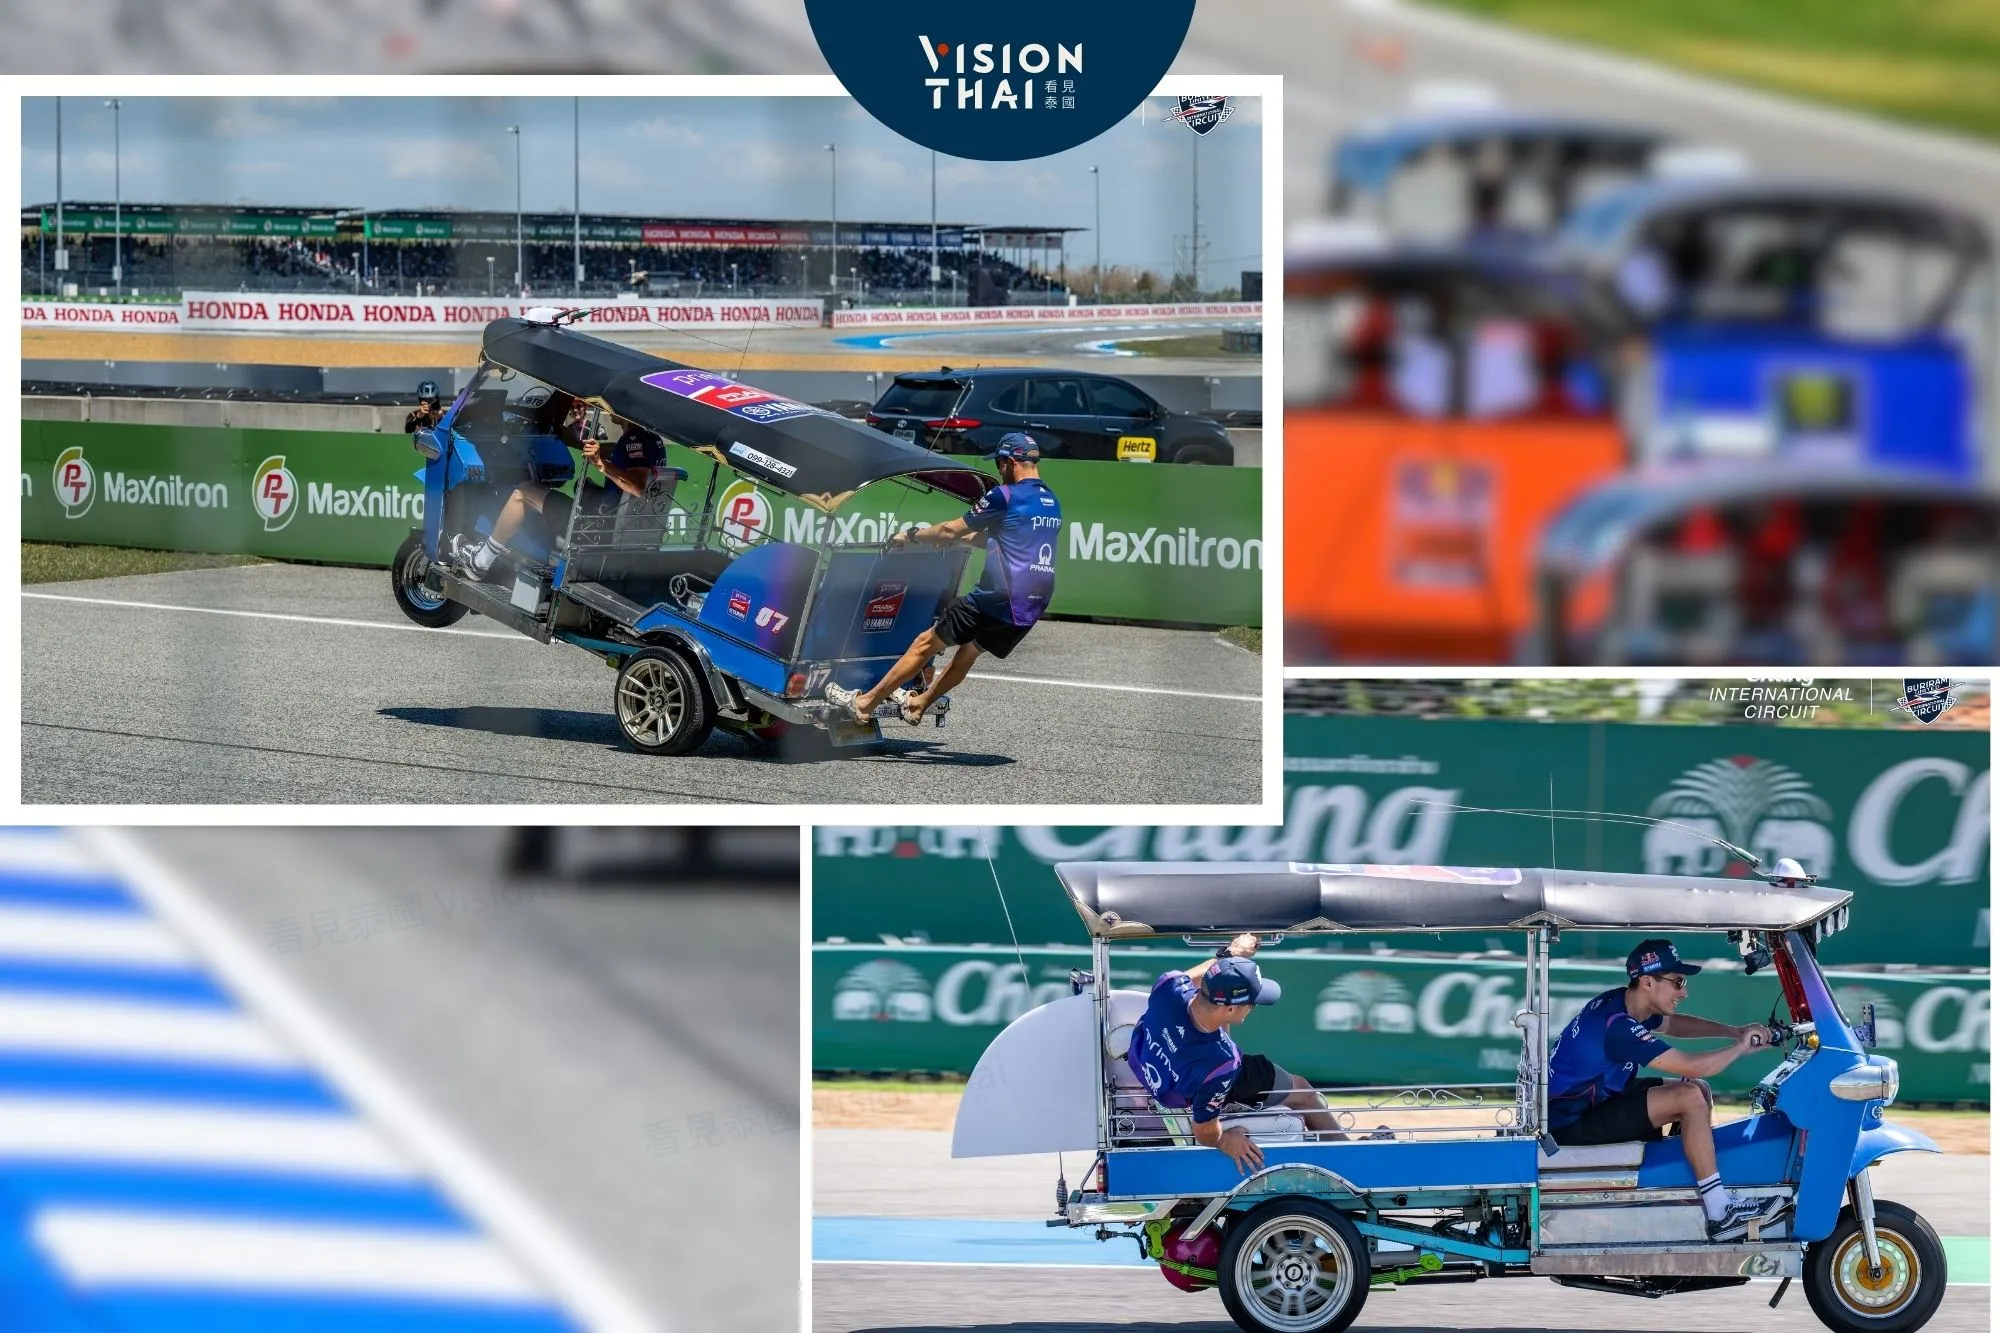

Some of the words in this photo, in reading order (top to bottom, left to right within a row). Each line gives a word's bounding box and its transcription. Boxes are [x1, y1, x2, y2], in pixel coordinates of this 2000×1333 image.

[54, 307, 114, 322] HONDA
[121, 310, 179, 323] HONDA
[187, 301, 269, 320] HONDA
[278, 303, 355, 322] HONDA
[363, 305, 436, 322] HONDA
[443, 306, 510, 323] HONDA
[590, 306, 651, 322] HONDA
[658, 306, 714, 322] HONDA
[720, 306, 770, 321] HONDA
[775, 306, 819, 321] HONDA
[836, 313, 867, 324] HONDA
[871, 312, 902, 322] HONDA
[906, 312, 937, 322] HONDA
[941, 310, 971, 321] HONDA
[974, 310, 1003, 320] HONDA
[1006, 310, 1034, 319] HONDA
[1123, 440, 1151, 452] Hertz
[747, 452, 793, 476] 099-128-4321
[103, 472, 228, 509] Maxnitron
[307, 482, 424, 520] Maxnitro
[1031, 516, 1061, 530] prim
[1069, 522, 1263, 570] Maxnitron
[755, 606, 789, 631] 07
